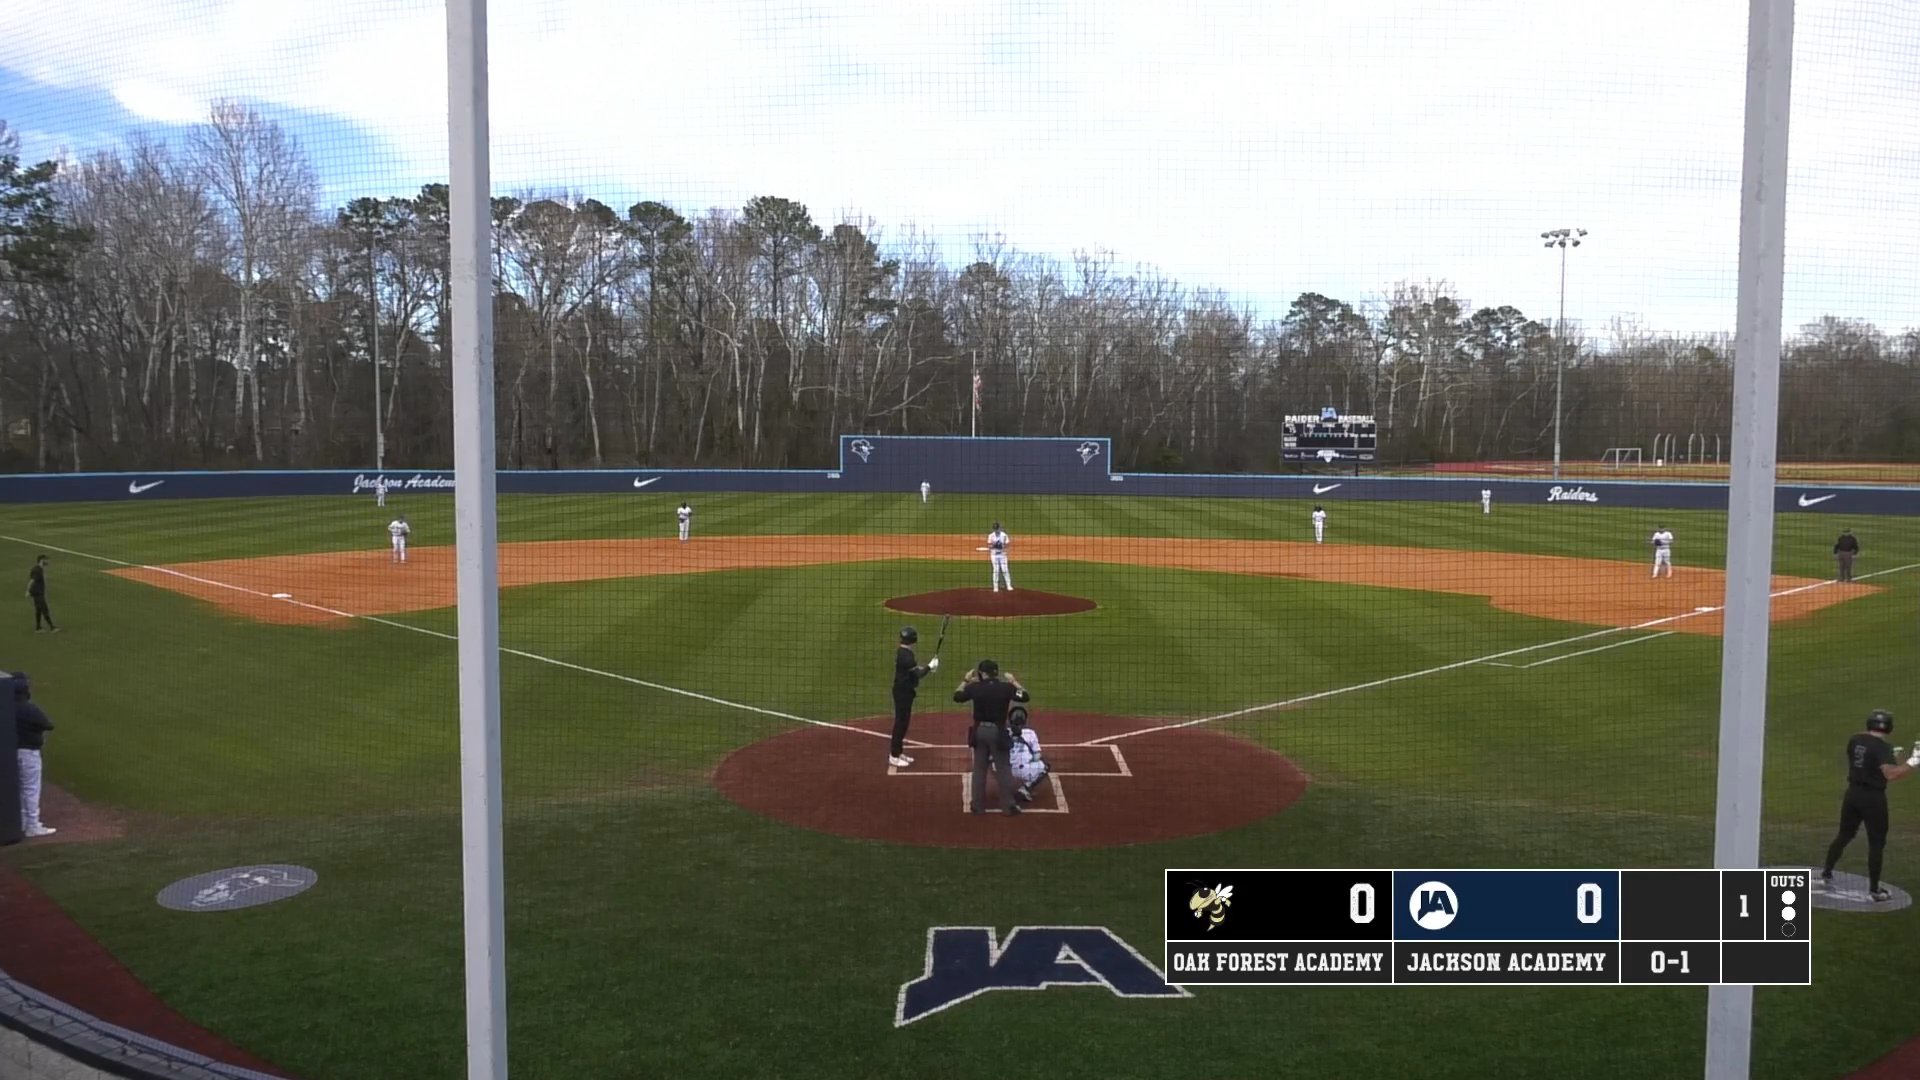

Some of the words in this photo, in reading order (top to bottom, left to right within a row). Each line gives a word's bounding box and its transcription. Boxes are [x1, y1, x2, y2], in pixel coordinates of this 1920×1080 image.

[1284, 415, 1320, 423] RAIDER
[1338, 415, 1375, 423] BASEBALL
[352, 474, 403, 493] Jackson
[404, 473, 456, 489] Academ
[1547, 486, 1599, 502] Raiders
[893, 926, 1195, 1028] JA
